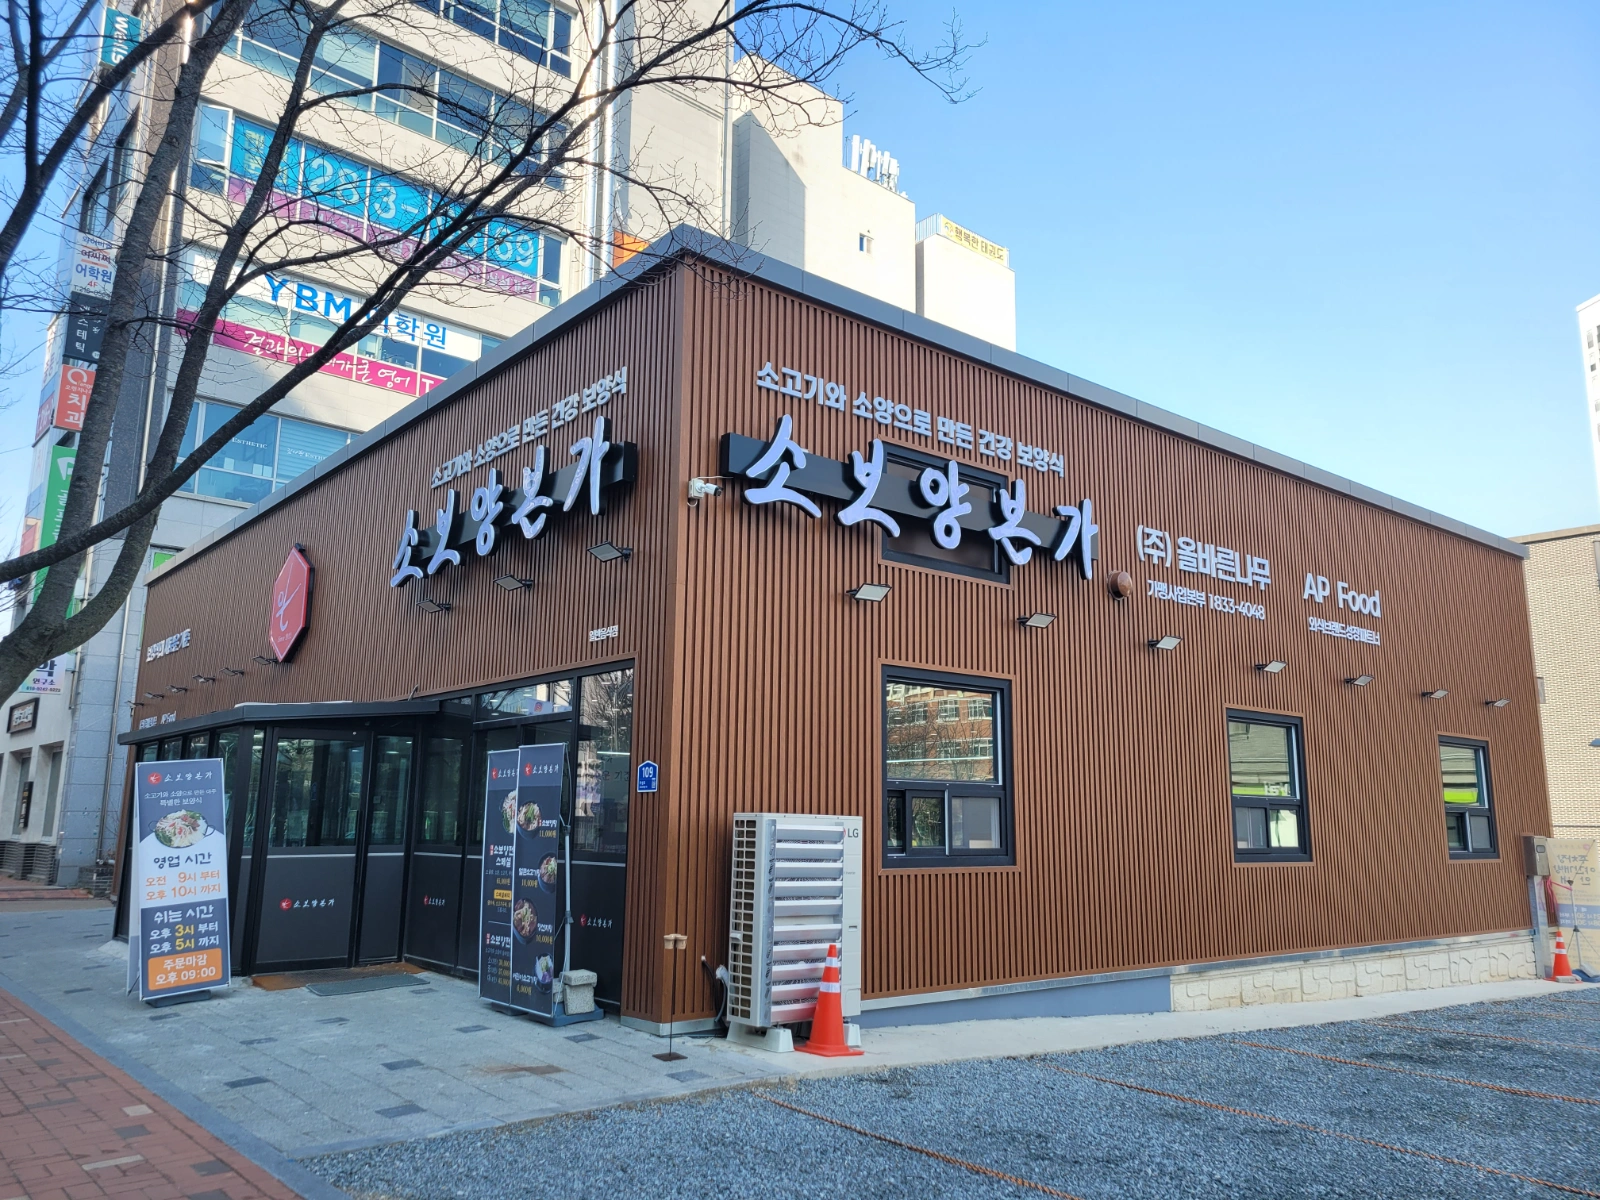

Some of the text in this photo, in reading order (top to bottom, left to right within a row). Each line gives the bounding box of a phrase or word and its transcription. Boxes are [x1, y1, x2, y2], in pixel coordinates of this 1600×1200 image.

[955, 226, 1004, 261] 행복한 태권도
[76, 263, 112, 284] 어학원
[265, 273, 351, 323] YBM
[378, 369, 410, 388] 영어
[431, 367, 627, 489] 소고기와 소양으로 만든 건강 보양식
[756, 362, 1065, 478] 소고기와 소양으로 만든 건강 보양식
[390, 416, 610, 587] 소보양본가
[744, 413, 1099, 580] 소보양본가
[1137, 525, 1271, 590] (주) 올바른나무
[1147, 579, 1265, 620] 가맹사업본부 1833-4048
[1303, 572, 1381, 617] AP Food
[32, 678, 56, 686] 연구소
[642, 766, 653, 778] 109
[182, 797, 202, 805] 보양식
[847, 828, 859, 838] LG
[153, 852, 212, 869] 영업 시간
[145, 869, 220, 887] 오전 9시 부터
[146, 883, 221, 900] 오후 10시 까지
[154, 904, 214, 924] 쉬는 시간
[149, 921, 218, 940] 오후 3시 부터
[149, 935, 219, 954] 오후 5시 까지
[163, 954, 207, 971] 주문마감
[155, 966, 216, 985] 오후 09:00
